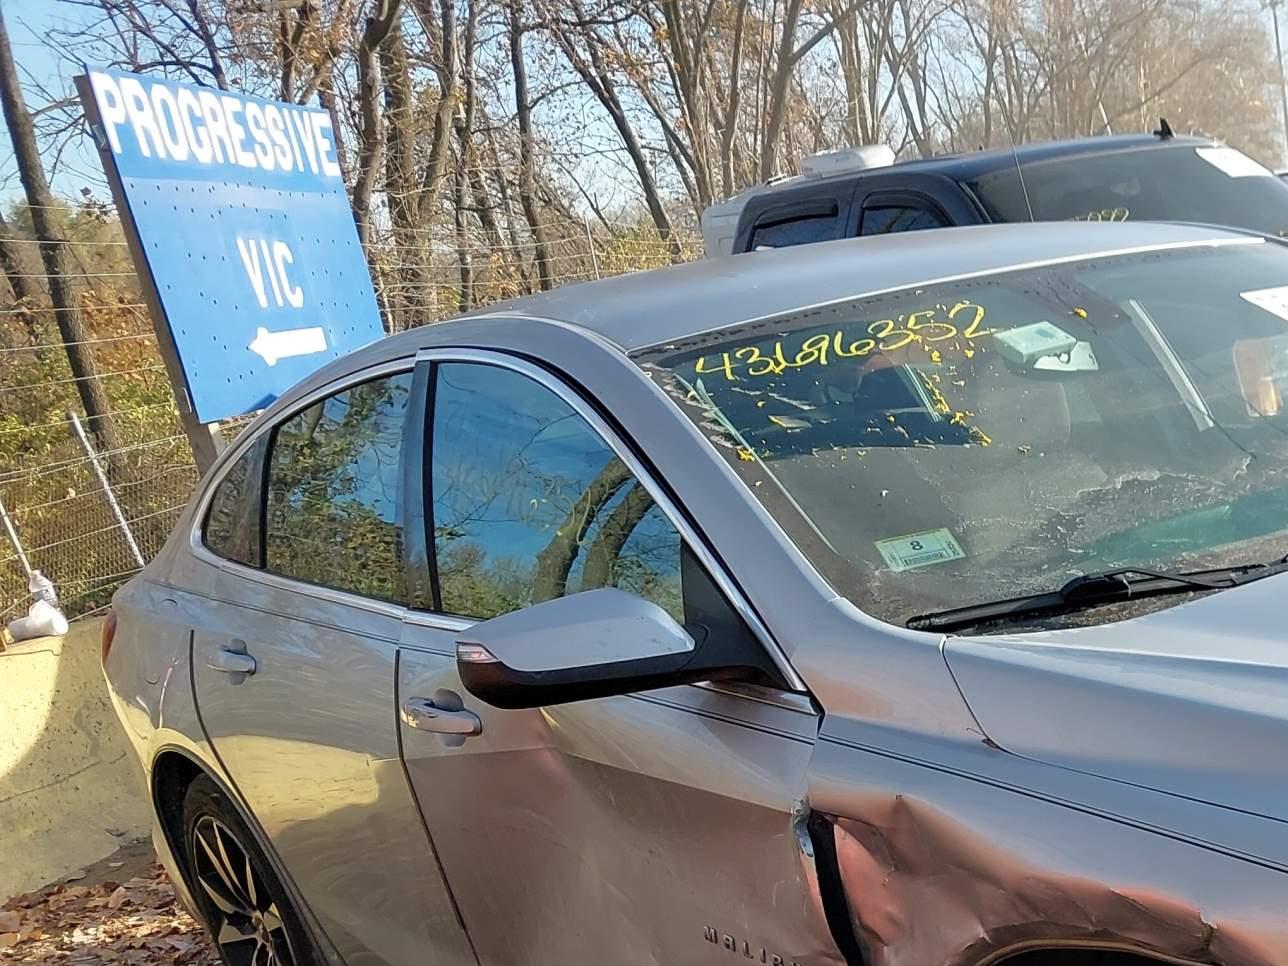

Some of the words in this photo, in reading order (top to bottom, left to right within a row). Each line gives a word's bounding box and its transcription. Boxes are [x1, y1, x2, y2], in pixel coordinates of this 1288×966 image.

[90, 71, 341, 177] PROGRESSIVE
[237, 237, 304, 308] VIC
[696, 300, 994, 381] 43696352
[910, 540, 924, 551] 8
